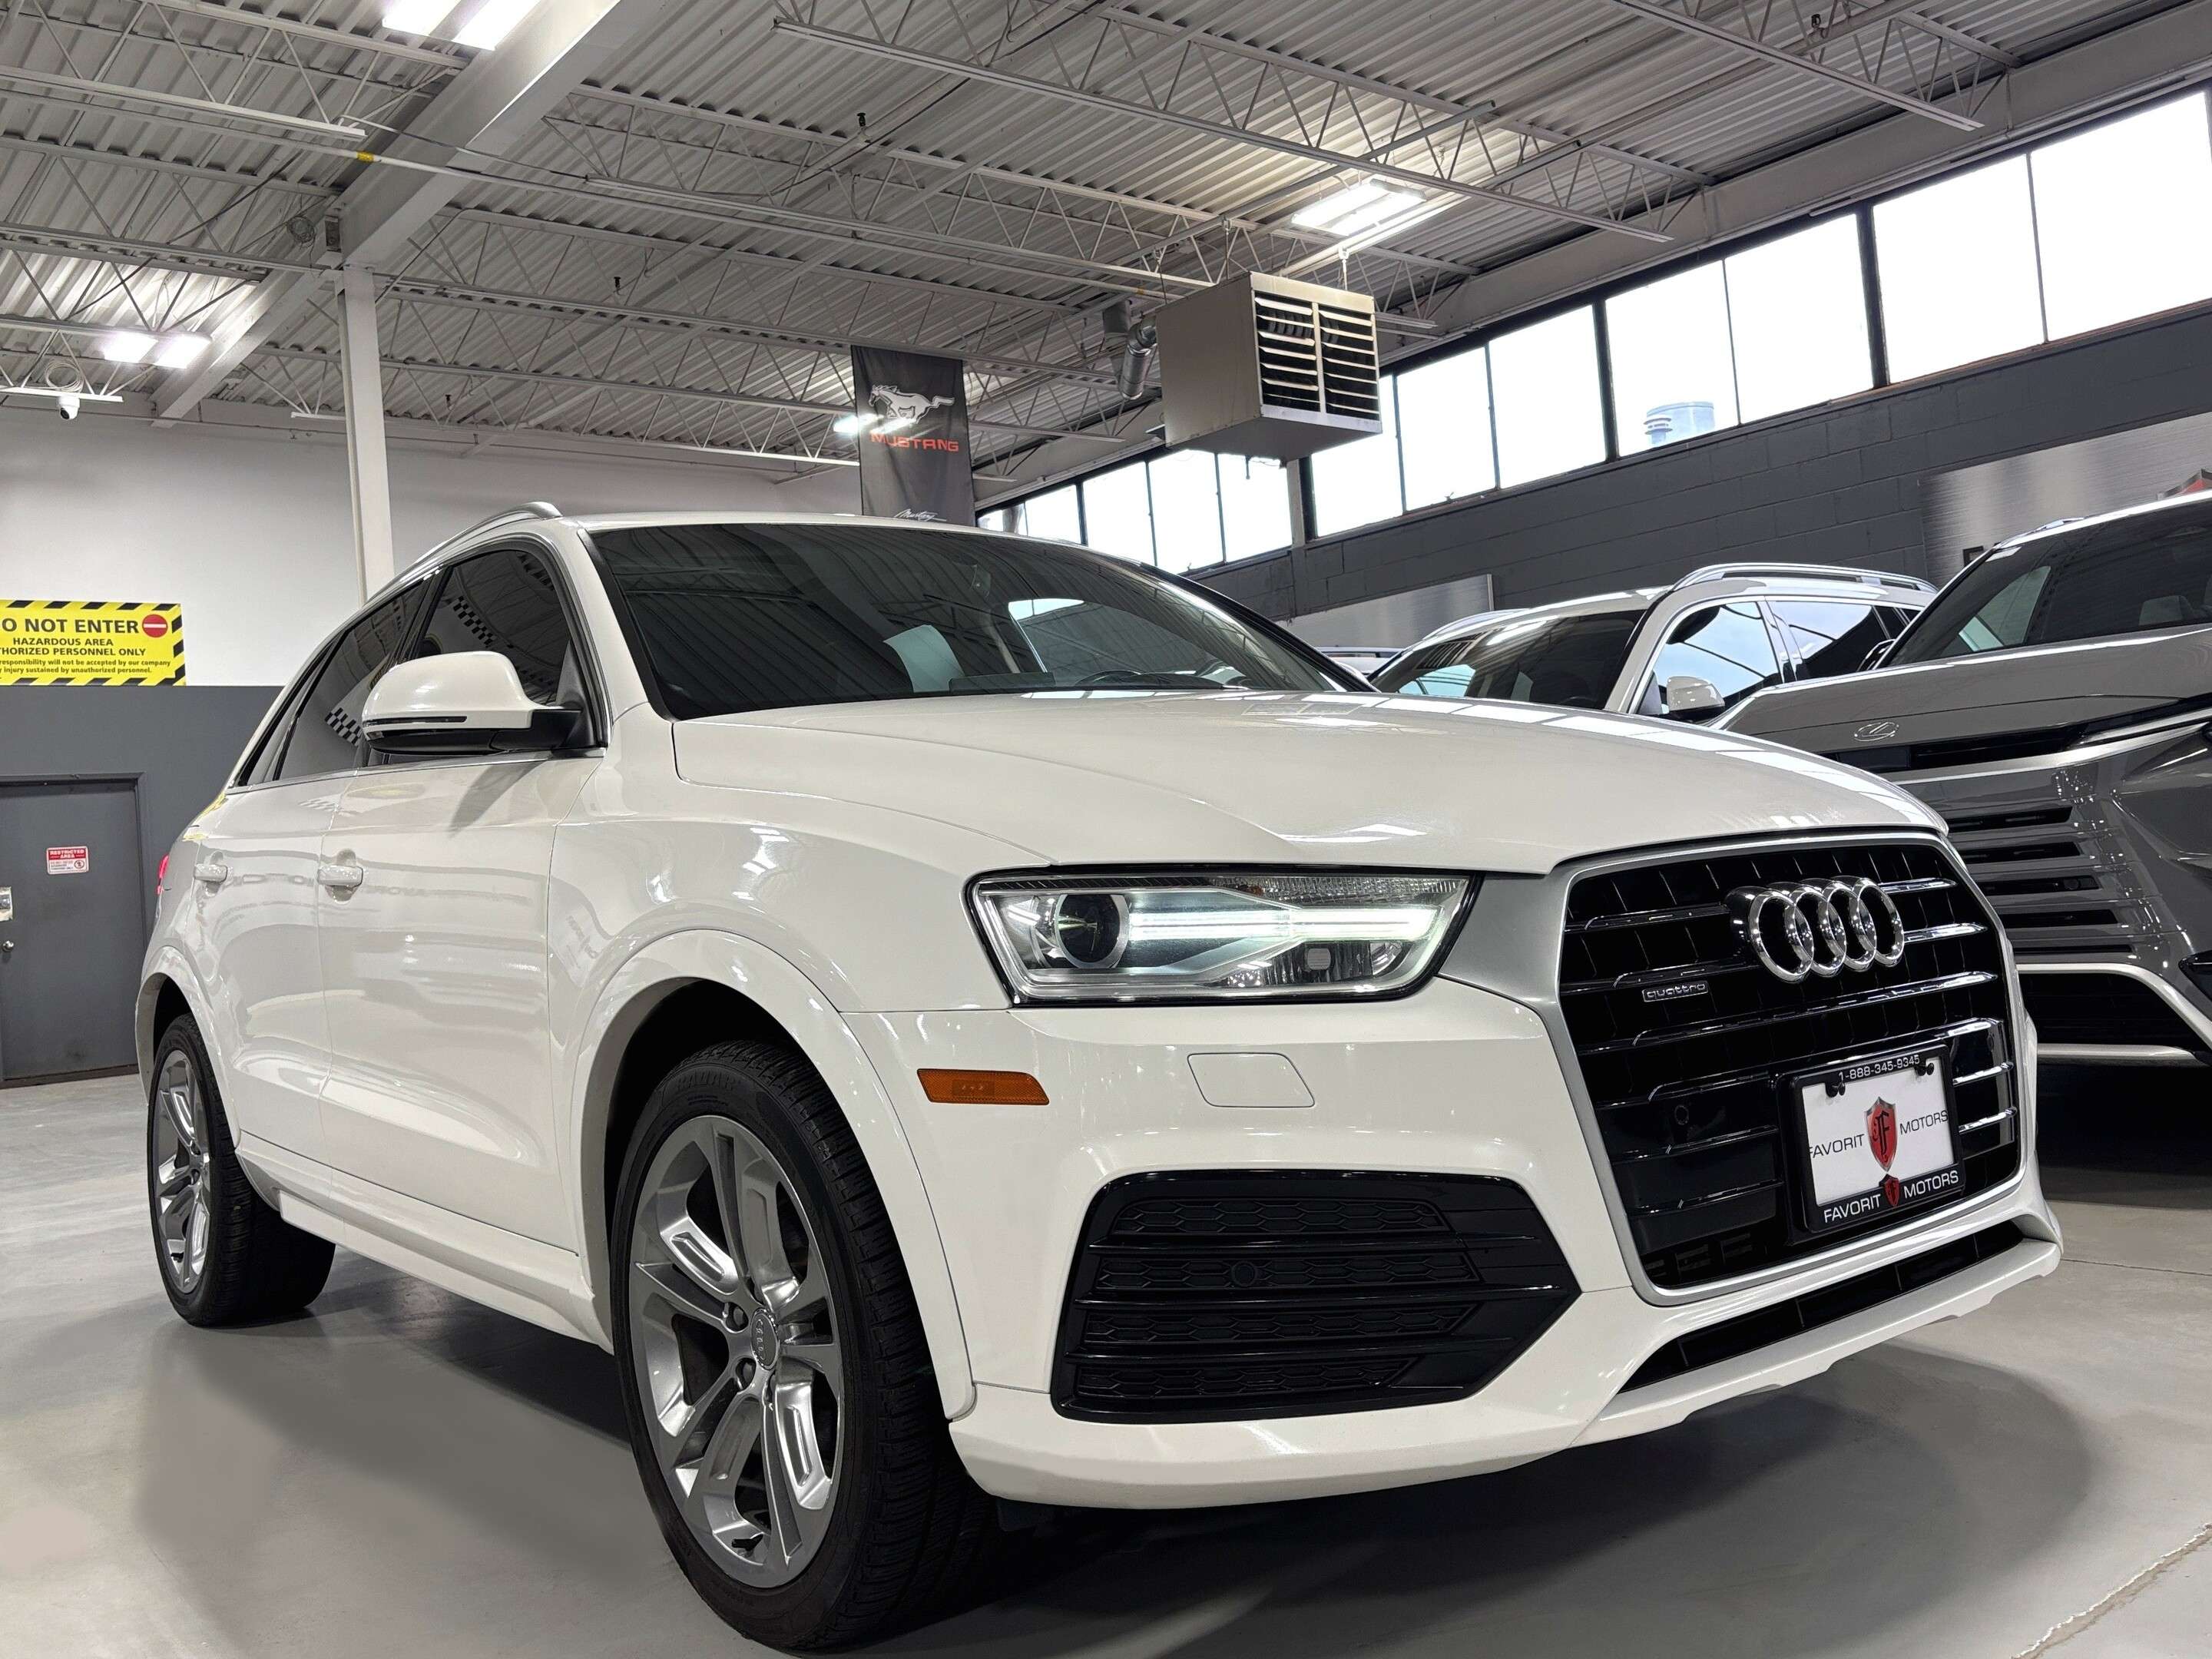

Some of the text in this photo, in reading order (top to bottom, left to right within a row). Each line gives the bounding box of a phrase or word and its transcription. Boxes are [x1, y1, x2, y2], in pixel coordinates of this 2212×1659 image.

[870, 432, 959, 452] MUSTANG
[25, 618, 68, 632] NOT
[75, 619, 140, 633] ENTER
[53, 647, 116, 656] PERSONNEL
[1647, 983, 1705, 999] quattro
[1839, 1055, 1920, 1081] 1-888-345-9345
[1899, 1110, 1949, 1135] MOTORS
[1823, 1170, 1959, 1223] FAVORIT MOTORS
